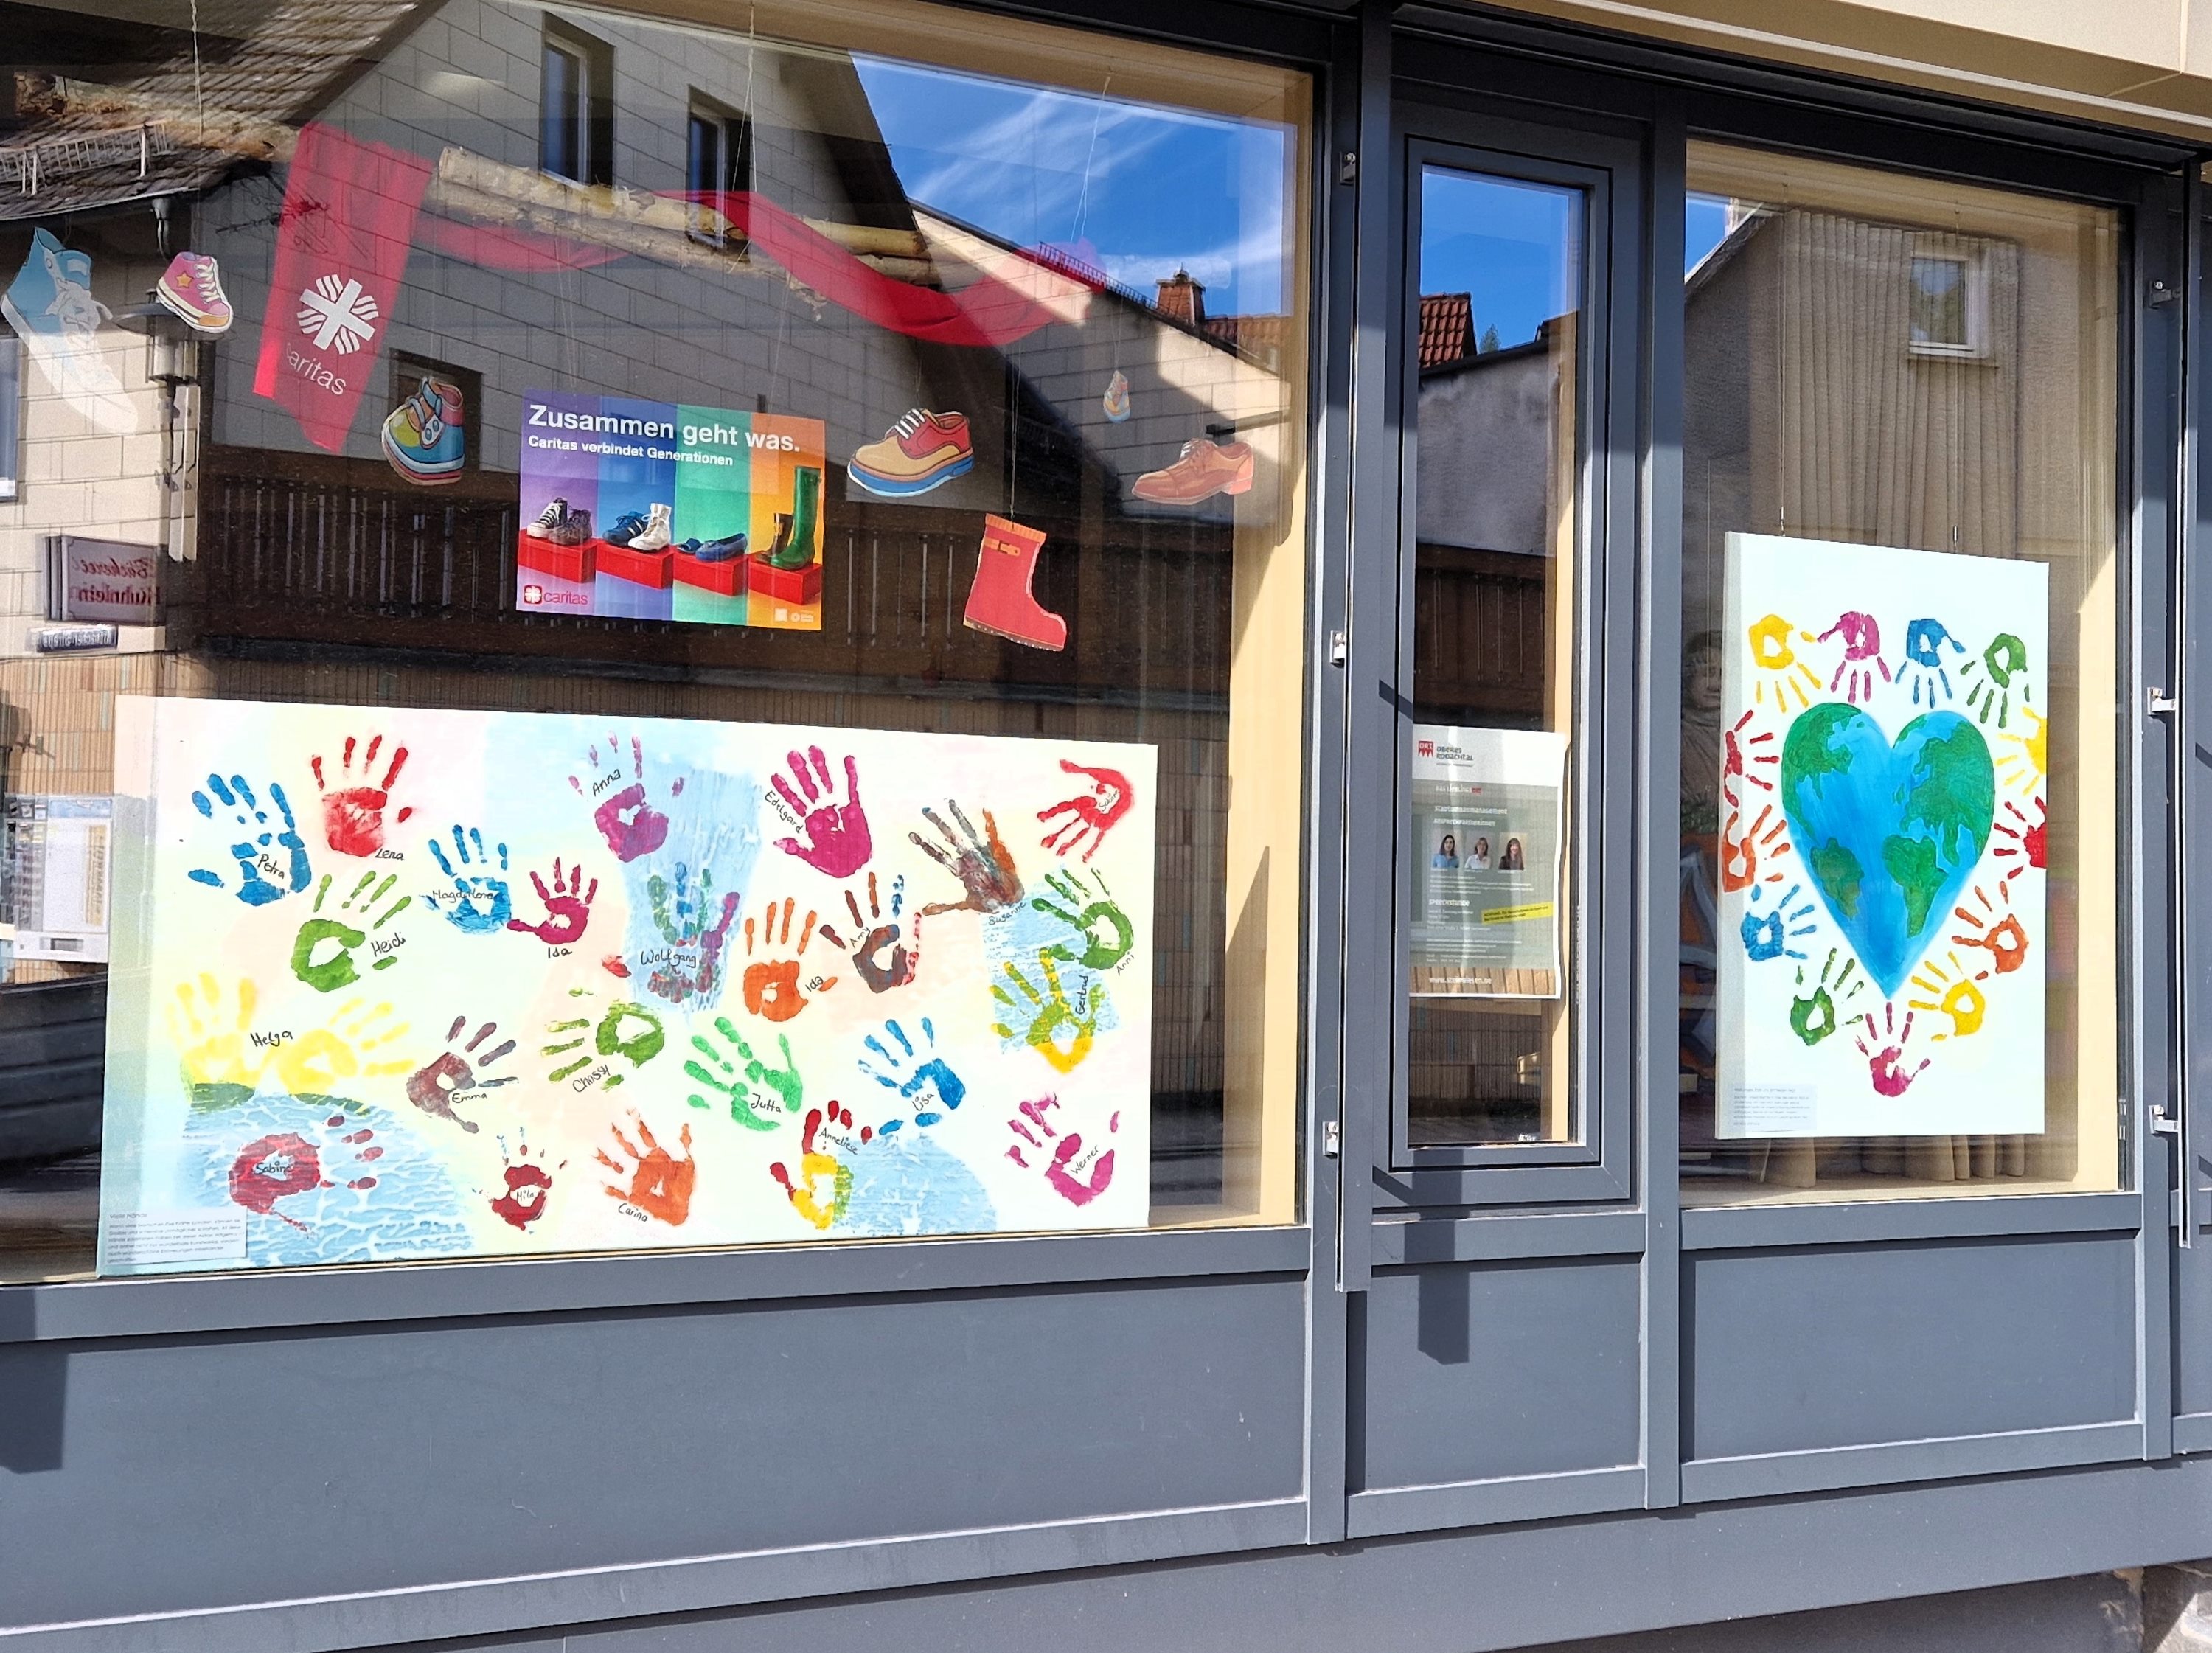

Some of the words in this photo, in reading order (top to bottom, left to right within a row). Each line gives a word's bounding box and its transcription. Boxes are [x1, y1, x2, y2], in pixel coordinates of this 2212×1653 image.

[529, 405, 674, 439] Zusammen
[683, 425, 737, 445] geht
[745, 433, 800, 452] was.
[529, 436, 577, 451] Caritas
[582, 441, 644, 457] verbindet
[647, 447, 733, 466] Generationen
[543, 591, 588, 605] caritas
[593, 768, 621, 796] Anna
[765, 790, 804, 834] Edelgard
[375, 848, 405, 861] Lena
[258, 854, 285, 879] Petra
[988, 902, 1026, 925] Susanne
[371, 932, 406, 957] Heidi
[849, 927, 871, 948] Amy
[548, 947, 571, 958] Ida
[641, 950, 697, 968] Wolfgang
[1116, 951, 1135, 976] Anni
[805, 975, 825, 993] Ida
[1075, 975, 1088, 1015] Gertrud
[250, 1029, 293, 1048] Helga
[451, 1090, 488, 1103] Emma
[751, 1093, 782, 1113] Jutta
[912, 1091, 935, 1112] Lisa
[819, 1127, 858, 1155] Anneliese
[1071, 1144, 1099, 1175] Werner
[516, 1189, 535, 1201] Mila
[618, 1203, 648, 1223] Carina
